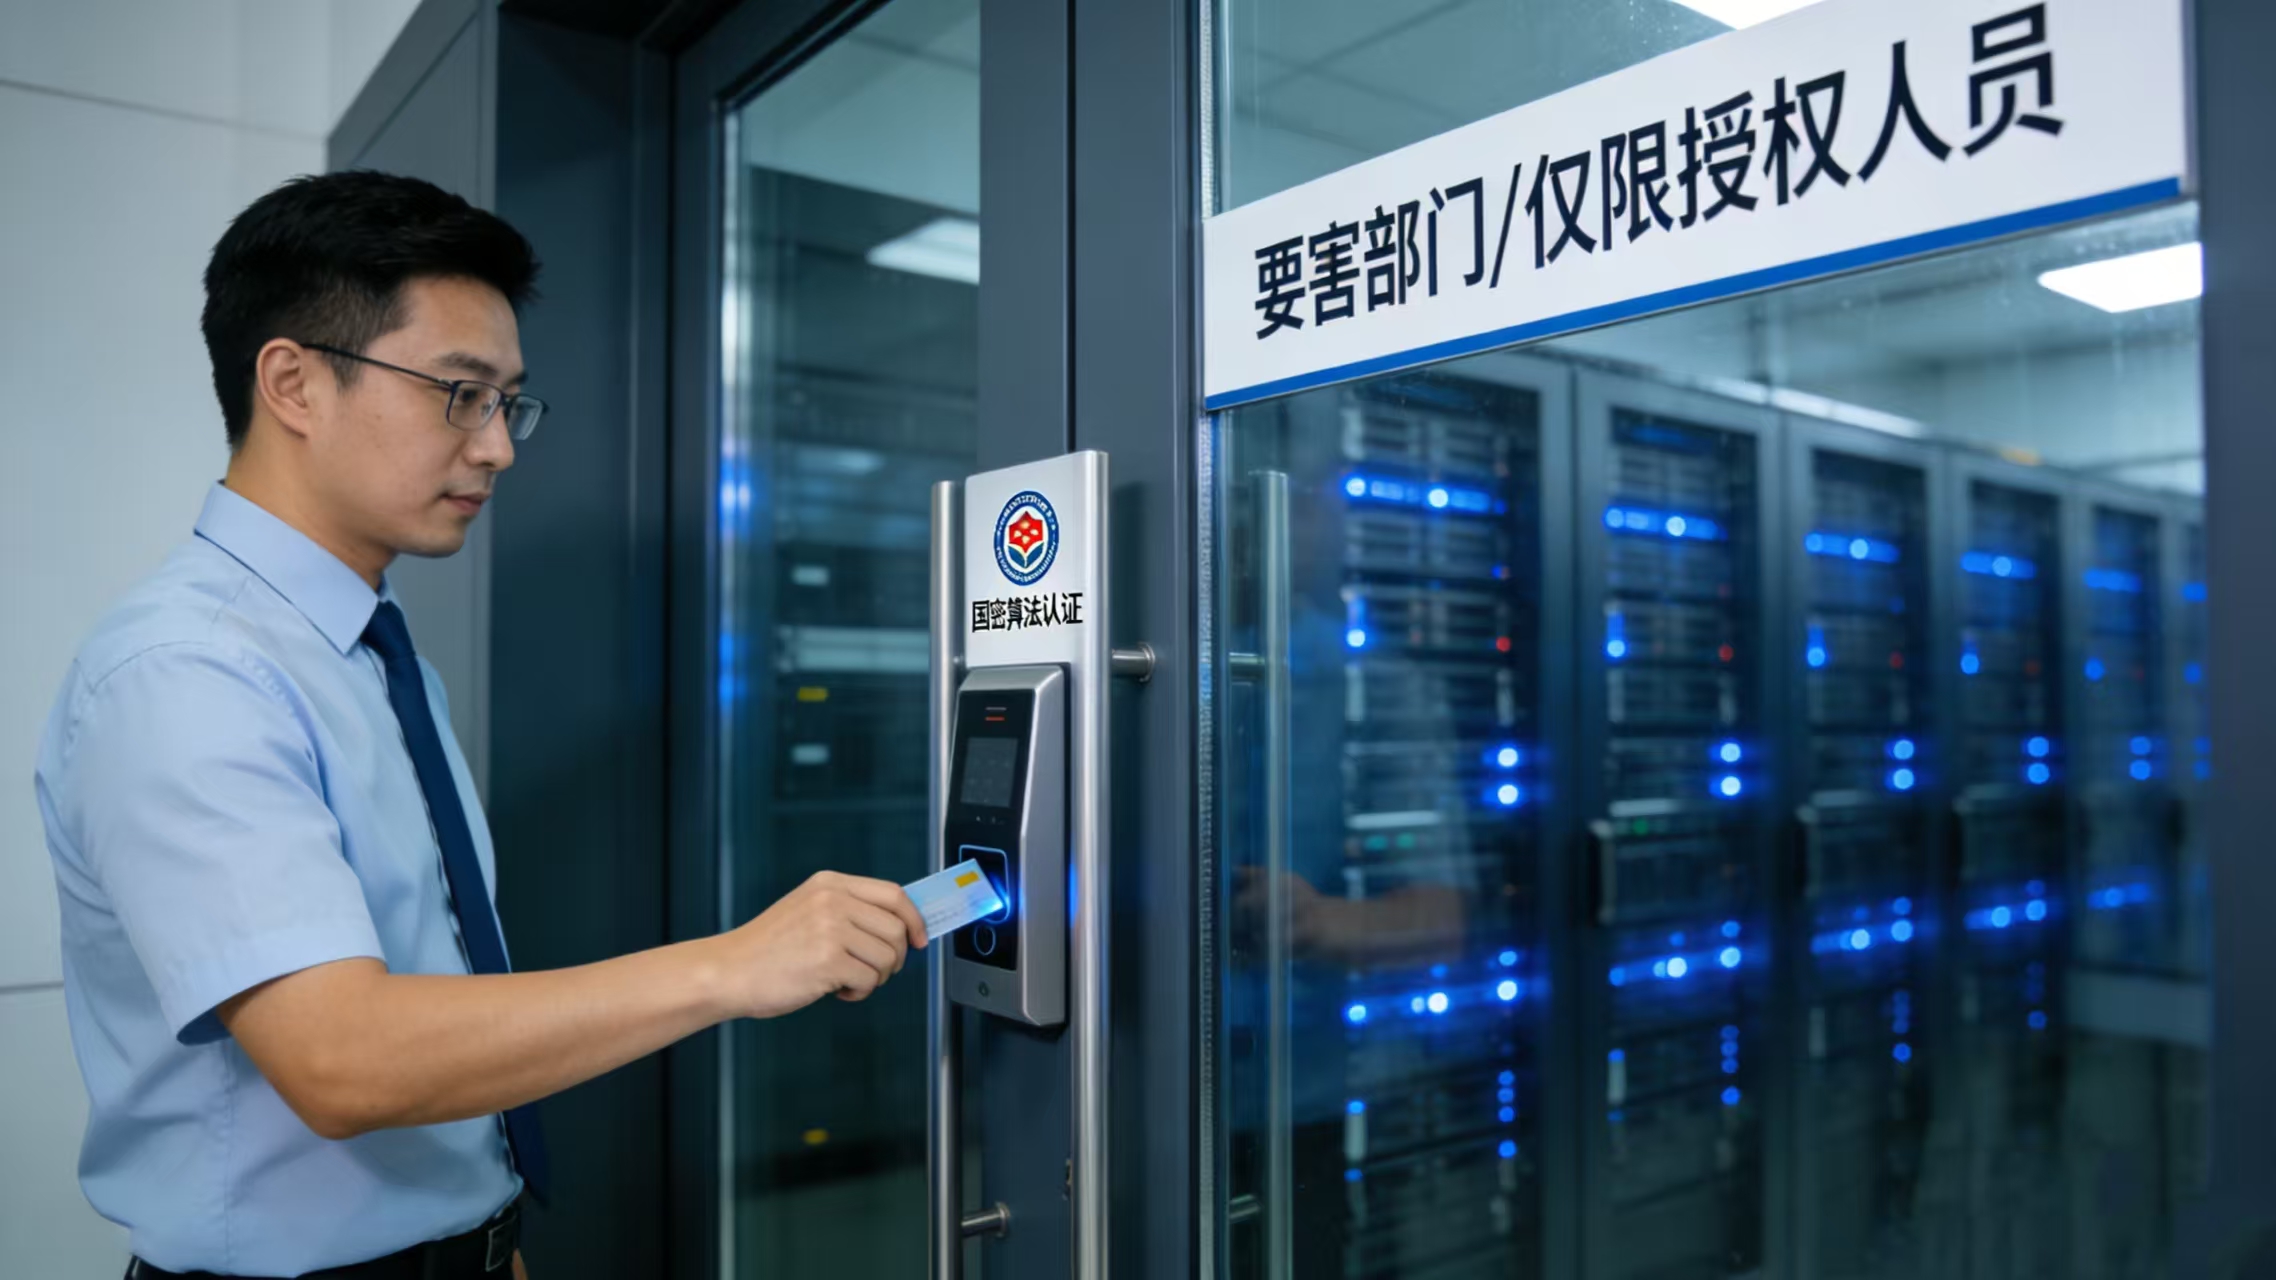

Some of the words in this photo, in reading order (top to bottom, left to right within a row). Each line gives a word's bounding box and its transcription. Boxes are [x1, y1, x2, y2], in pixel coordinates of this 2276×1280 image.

[1254, 2, 2064, 340] 要害部门/仅限授权人员
[972, 592, 1083, 633] 国密算法认证
